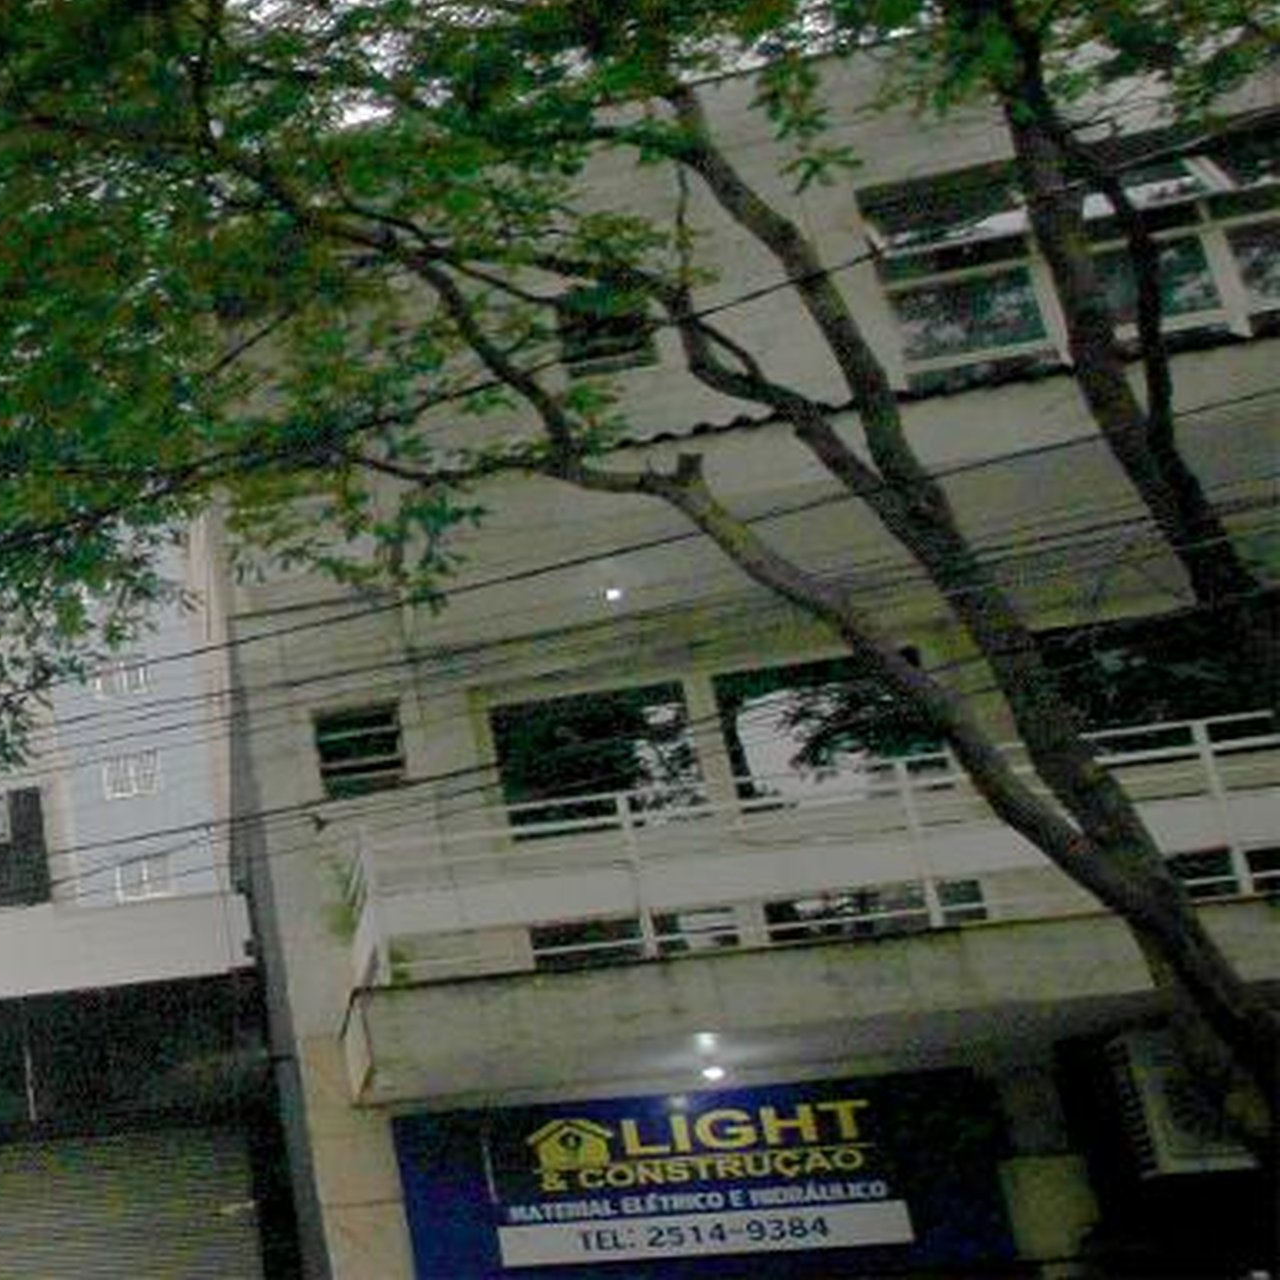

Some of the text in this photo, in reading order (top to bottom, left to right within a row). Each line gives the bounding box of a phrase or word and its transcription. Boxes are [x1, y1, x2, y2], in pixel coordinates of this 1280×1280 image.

[621, 1099, 869, 1156] LIGHT
[509, 1199, 618, 1222] MATERIAL
[729, 1190, 745, 1207] E
[582, 1217, 829, 1251] TEL: 2514-9384
